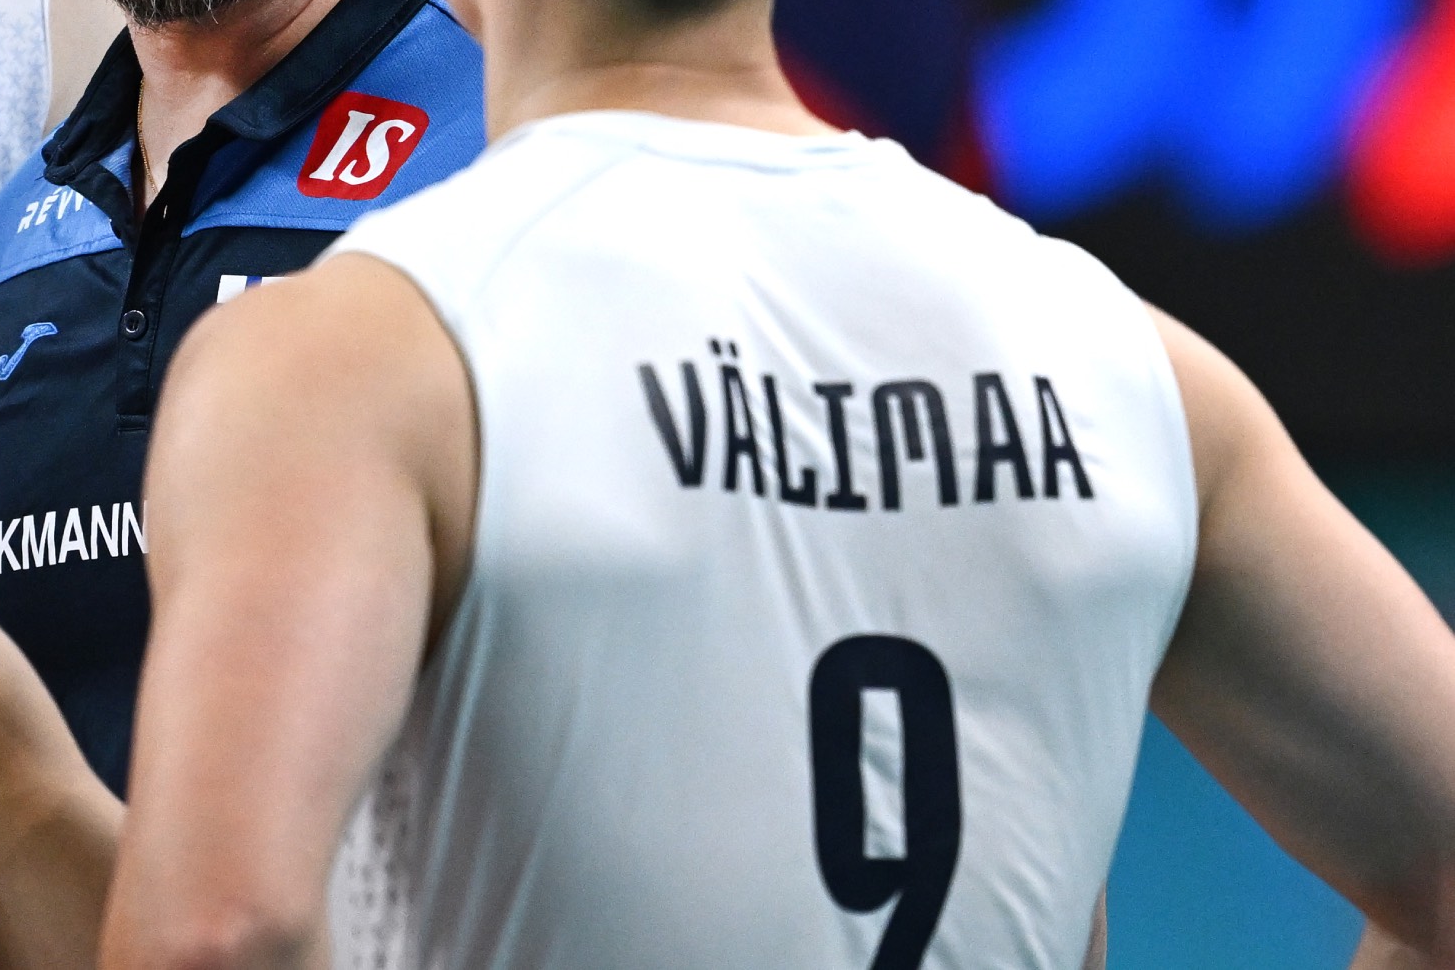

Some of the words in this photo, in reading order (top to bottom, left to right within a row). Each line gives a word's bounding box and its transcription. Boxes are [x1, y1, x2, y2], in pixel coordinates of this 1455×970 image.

[308, 109, 417, 186] IS
[635, 337, 1097, 512] VÄLIMAA
[808, 632, 965, 970] 9
